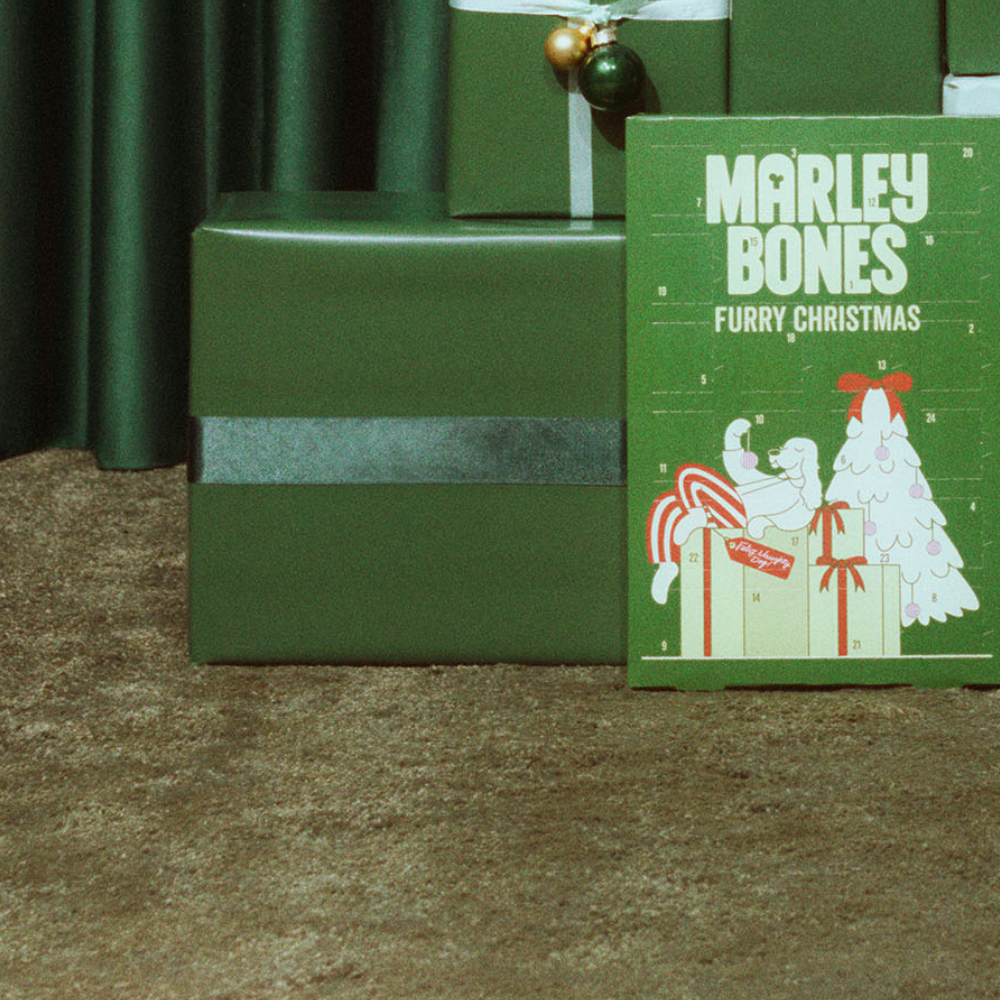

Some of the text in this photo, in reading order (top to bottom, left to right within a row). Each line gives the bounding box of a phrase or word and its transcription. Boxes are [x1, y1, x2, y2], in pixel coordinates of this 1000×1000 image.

[791, 148, 798, 158] 3
[706, 153, 928, 223] MARLEY
[696, 197, 702, 207] 7
[868, 198, 876, 207] 12
[750, 237, 758, 247] 15
[727, 224, 908, 295] BONES
[714, 304, 921, 333] FURRY CHRISTMAS
[968, 324, 974, 334] 2
[878, 360, 887, 370] 13
[701, 374, 707, 385] 5
[926, 413, 936, 423] 24
[970, 502, 976, 512] 4
[688, 553, 699, 563] 22
[880, 554, 890, 563] 23
[752, 593, 760, 603] 14
[932, 593, 937, 603] 8
[852, 640, 861, 650] 21
